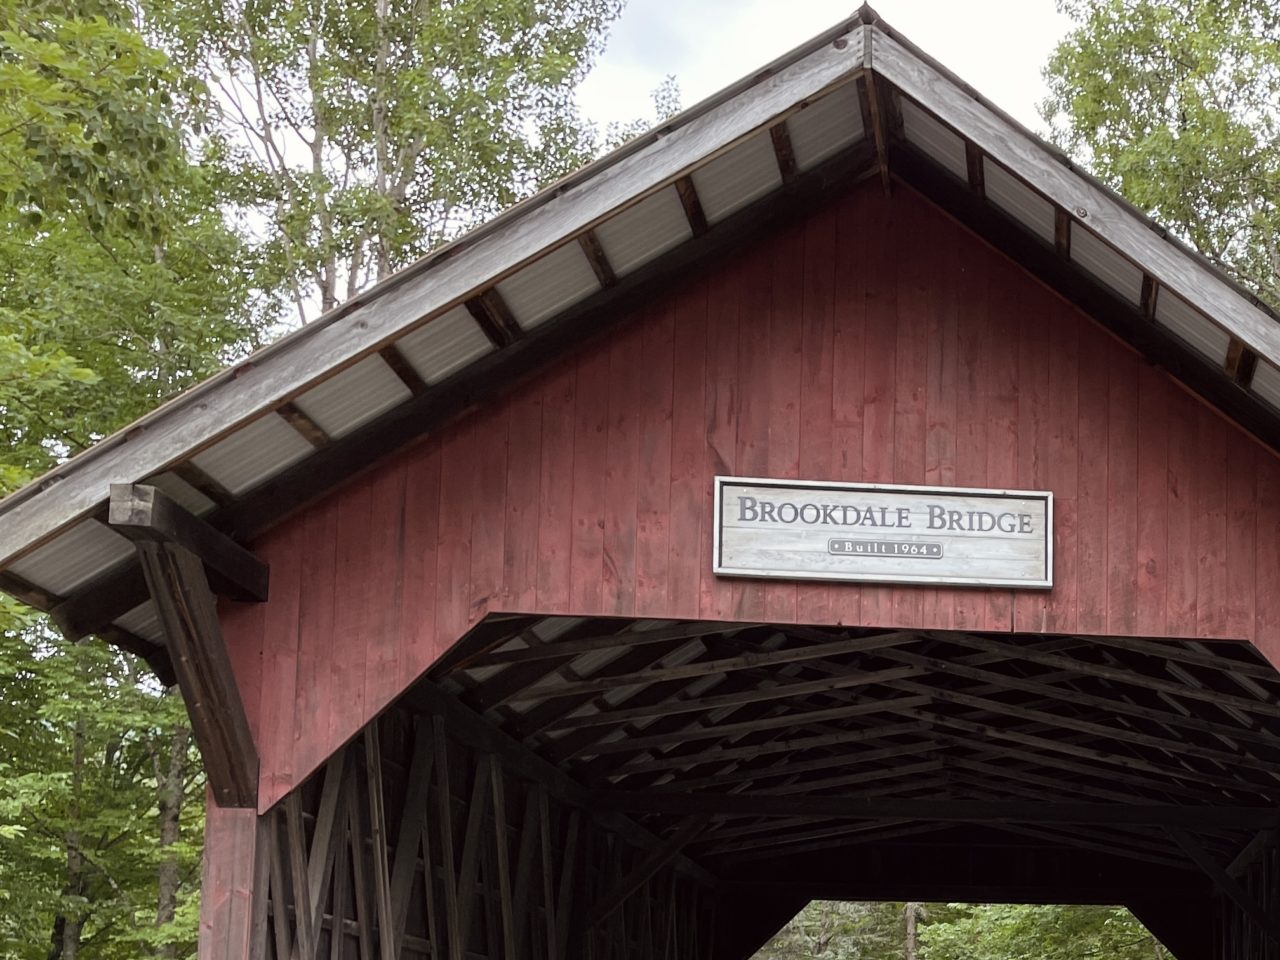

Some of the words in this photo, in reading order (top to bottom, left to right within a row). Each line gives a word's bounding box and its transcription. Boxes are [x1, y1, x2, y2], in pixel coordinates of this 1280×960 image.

[737, 496, 912, 529] BROOKDALE
[926, 504, 1034, 534] BRIDGE
[844, 541, 887, 553] Built
[893, 544, 928, 555] 1964
